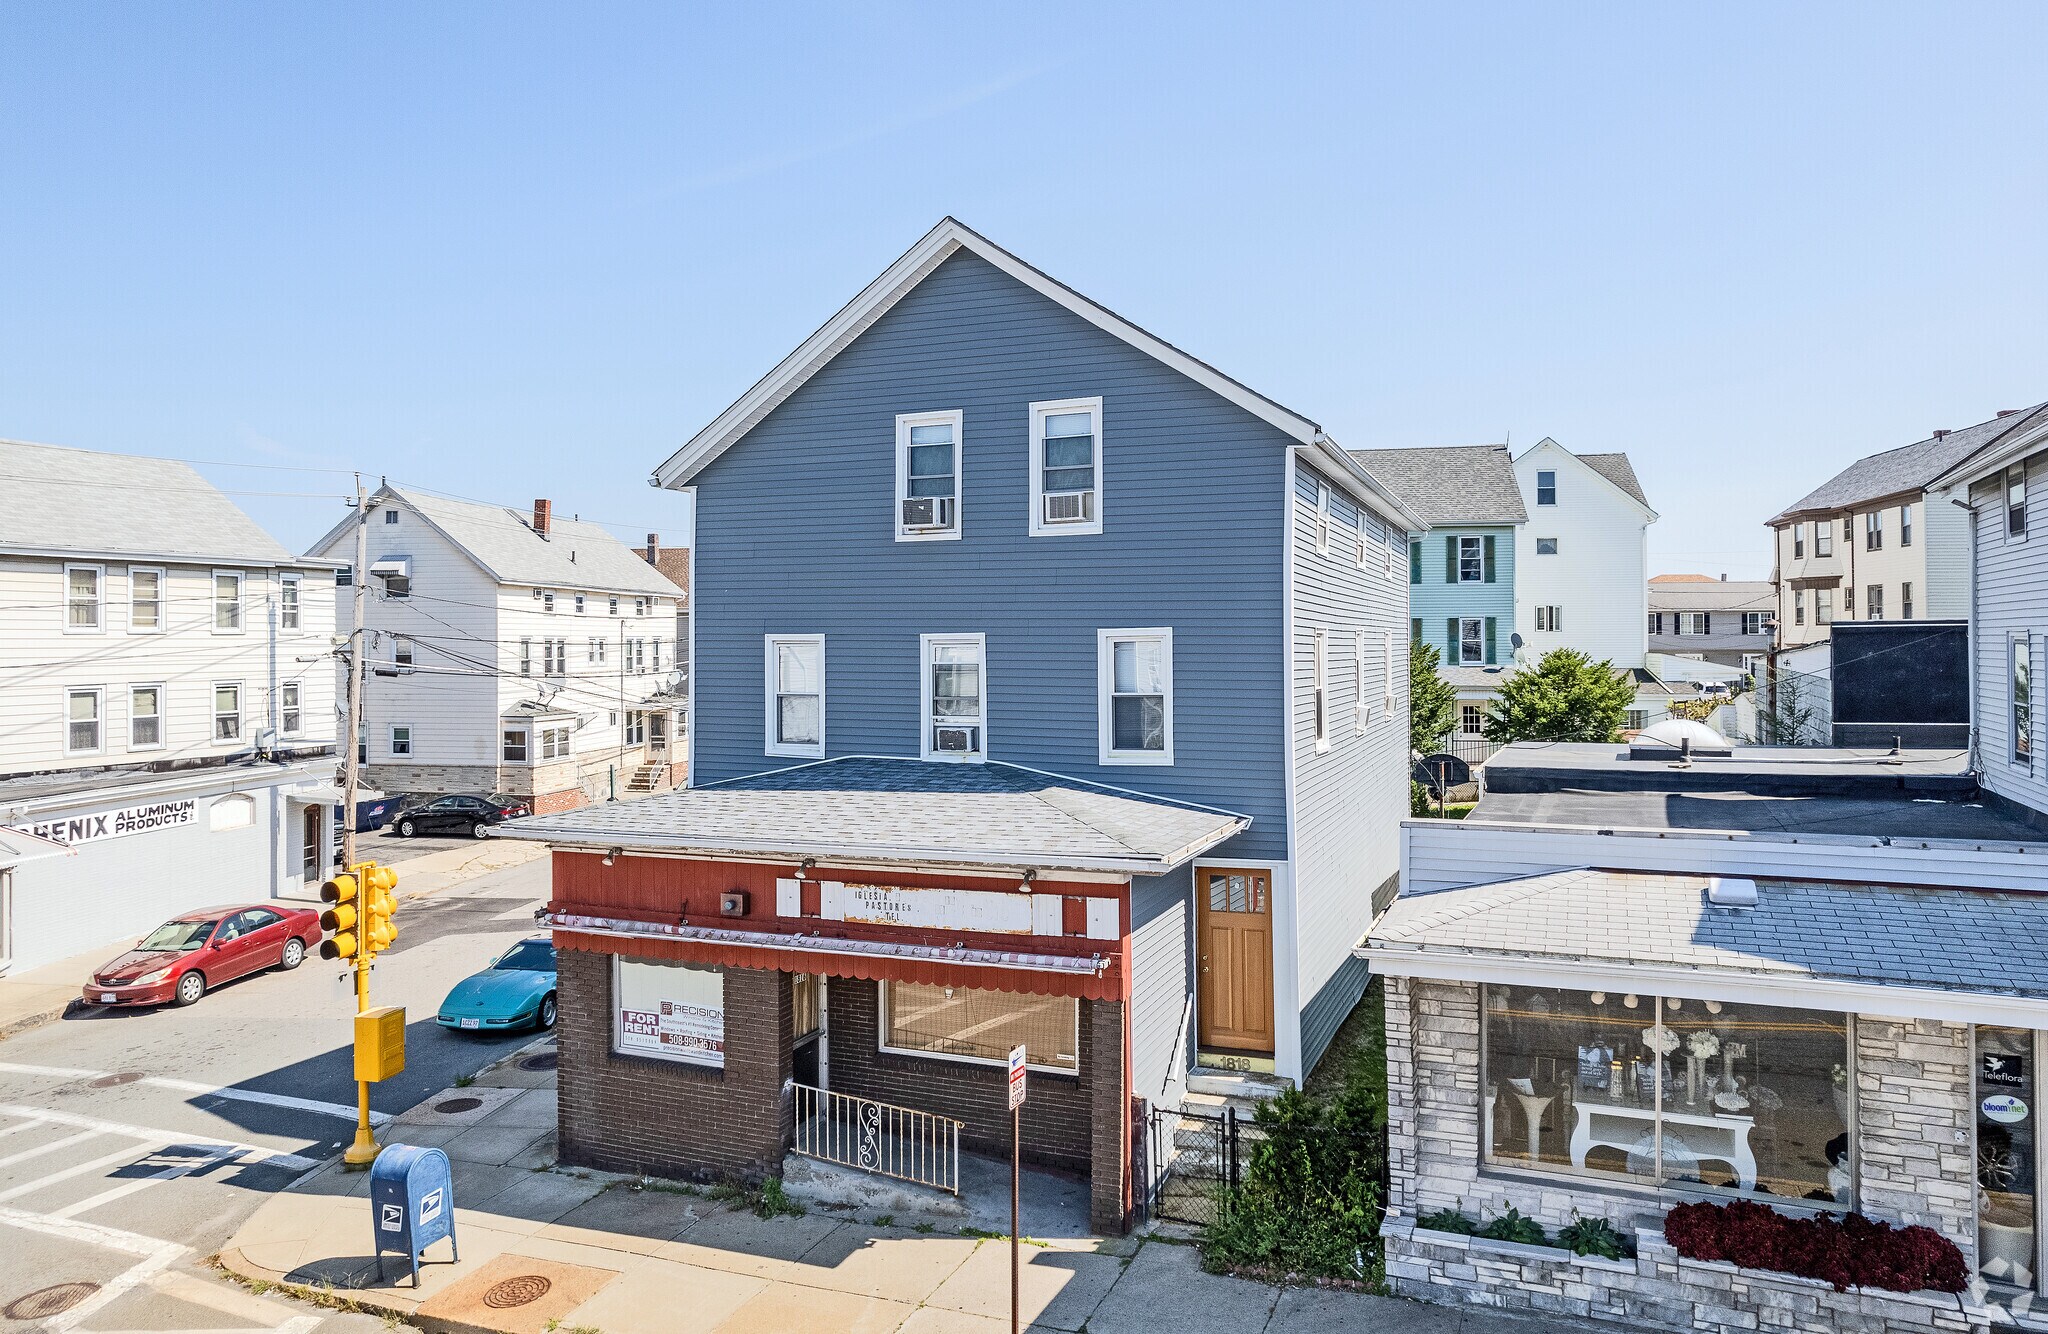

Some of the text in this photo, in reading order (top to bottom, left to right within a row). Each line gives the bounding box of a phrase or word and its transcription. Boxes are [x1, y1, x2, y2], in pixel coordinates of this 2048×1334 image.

[115, 800, 195, 823] ALUMINUM
[115, 811, 188, 834] PRODUCTS
[854, 891, 888, 901] IGLESIA
[865, 901, 912, 912] PASTORES
[628, 1013, 656, 1025] FOR
[624, 1021, 659, 1036] RENT
[668, 1034, 717, 1051] 508-990-3576
[1220, 1056, 1251, 1070] 1818
[1982, 1069, 2023, 1083] Teleflora
[1012, 1079, 1023, 1093] BUS
[1011, 1089, 1024, 1106] STOP
